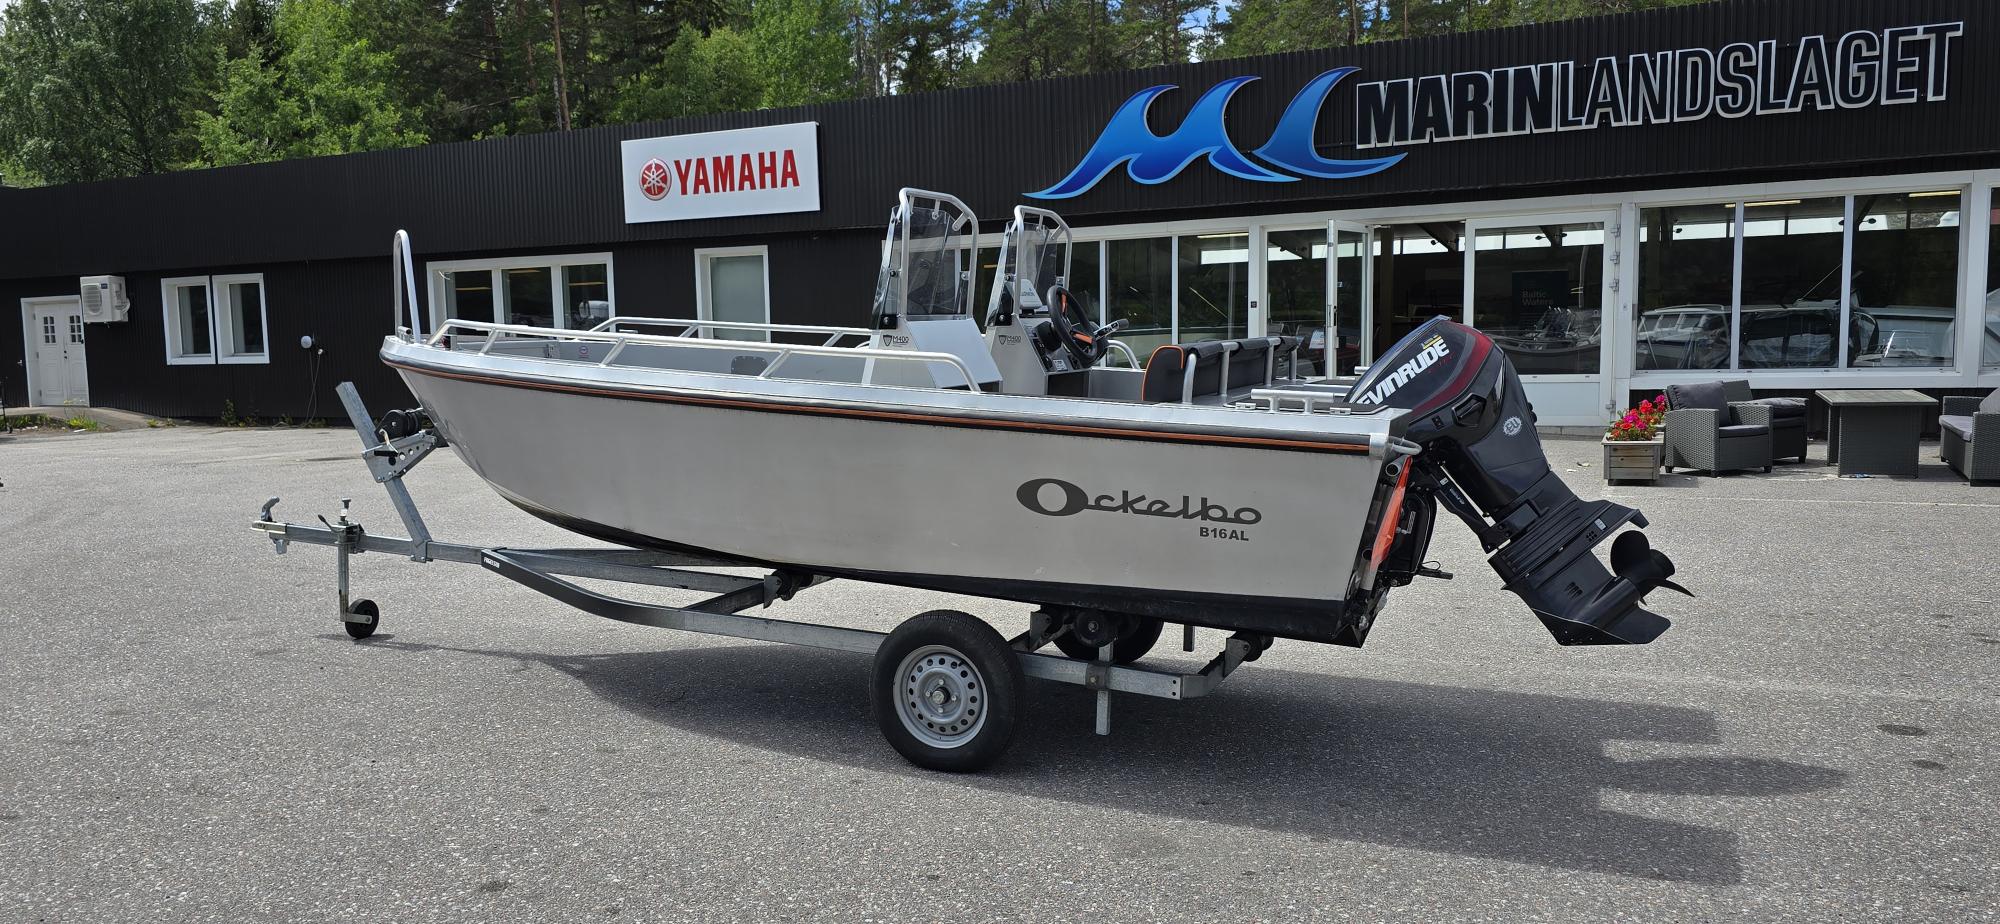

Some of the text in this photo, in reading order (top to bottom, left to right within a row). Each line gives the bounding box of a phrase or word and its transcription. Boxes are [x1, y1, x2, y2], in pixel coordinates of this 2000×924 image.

[1356, 21, 1964, 150] MARINLANDSLAGET
[674, 149, 800, 195] YAMAHA
[1016, 478, 1262, 525] Ockelbo
[1200, 526, 1249, 541] B16AL
